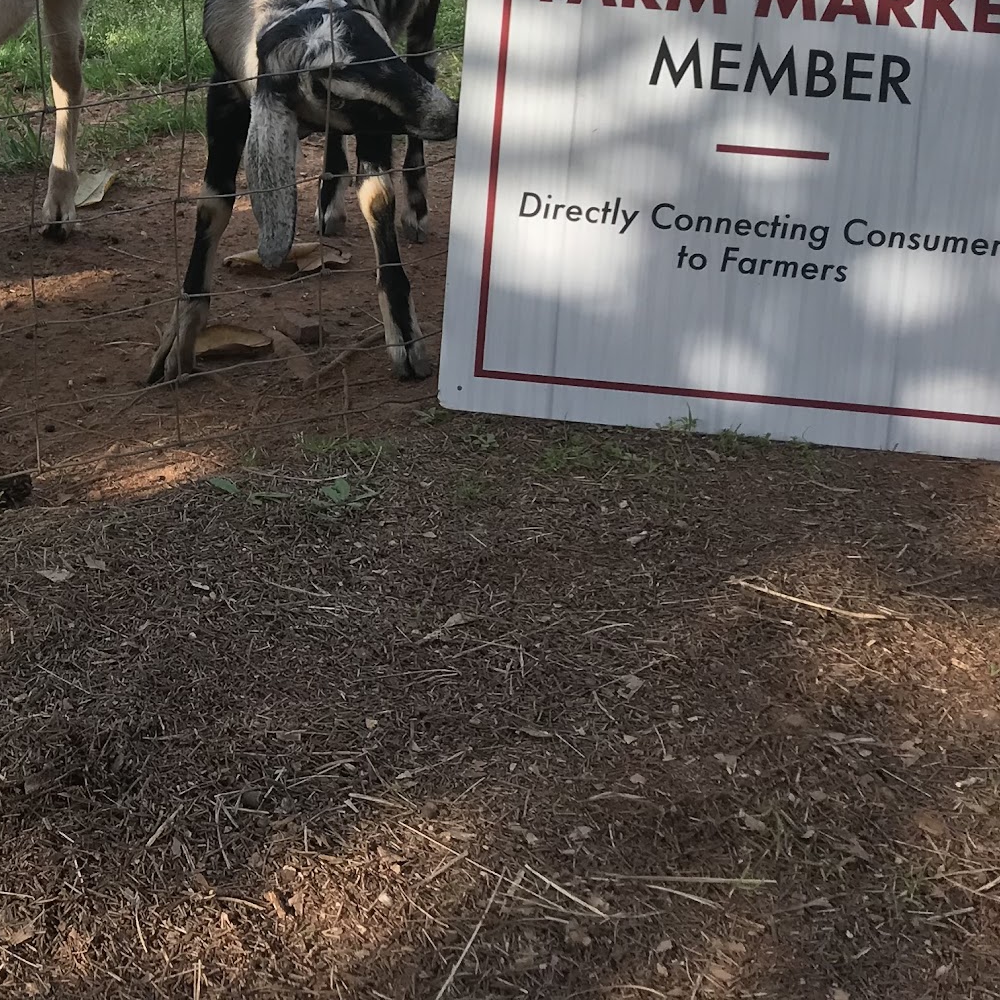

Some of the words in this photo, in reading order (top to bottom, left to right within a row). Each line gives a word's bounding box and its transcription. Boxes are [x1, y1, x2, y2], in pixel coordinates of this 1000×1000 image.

[649, 37, 912, 104] MEMBER
[519, 192, 640, 234] Directly
[651, 203, 830, 250] Connecting
[677, 245, 707, 270] to
[720, 246, 848, 282] Farmers
